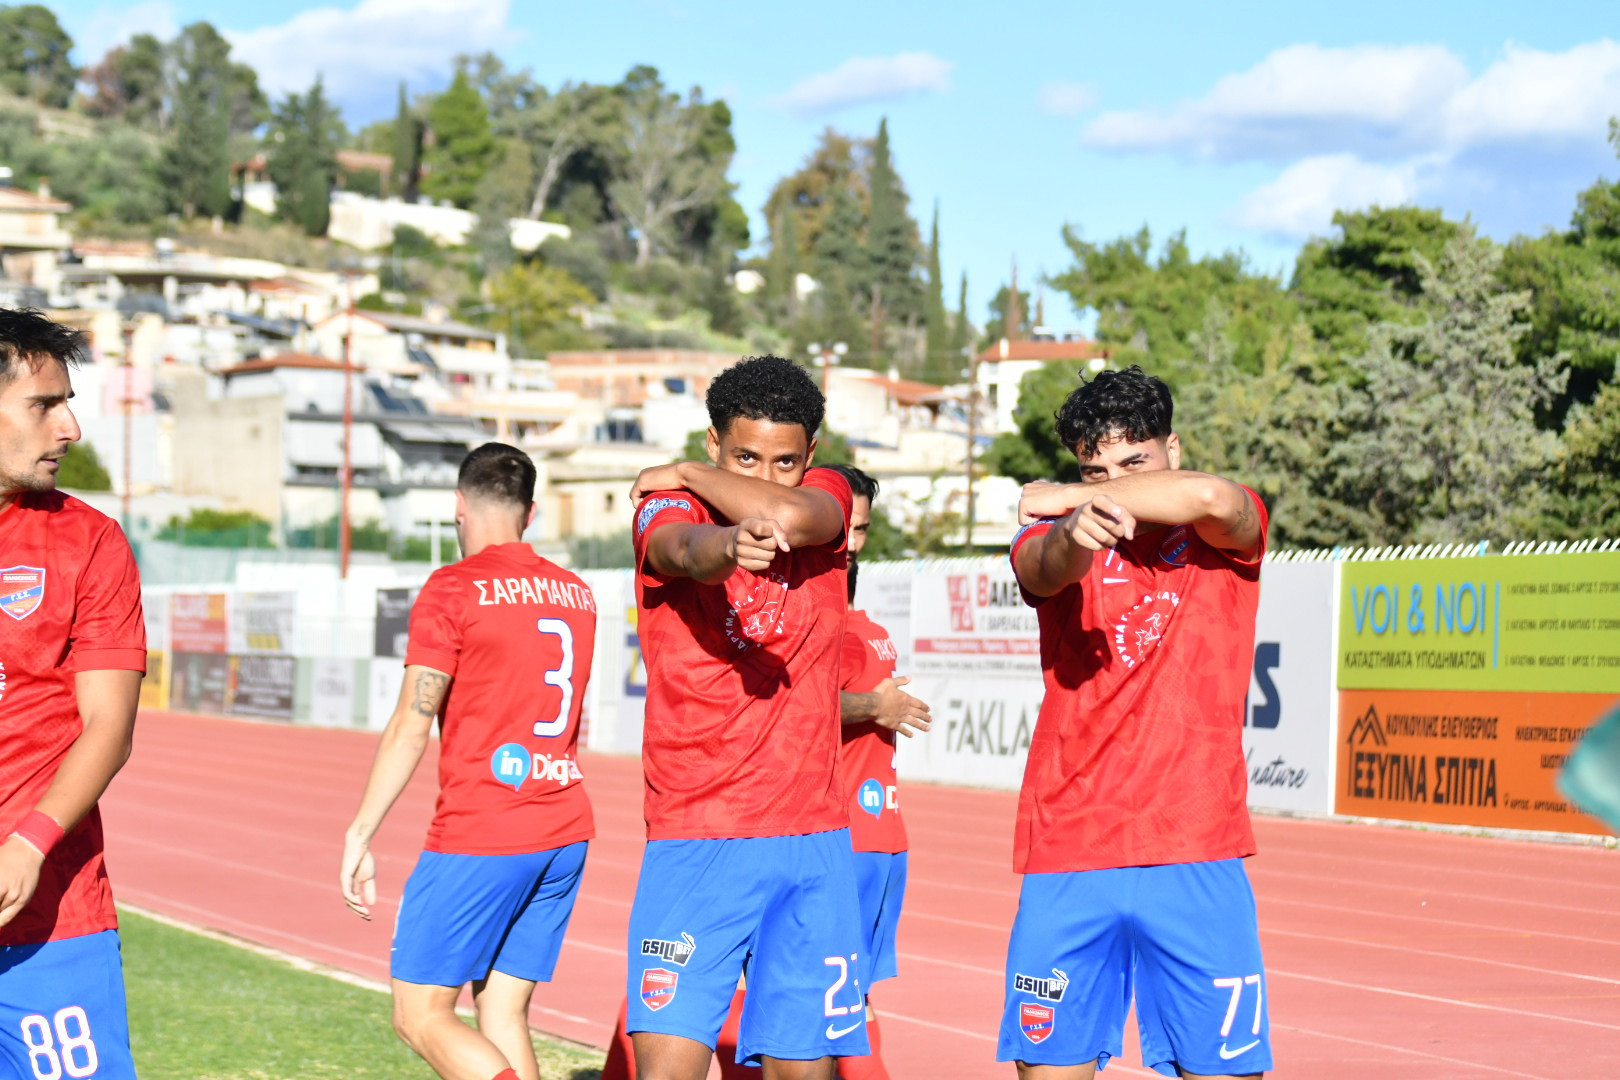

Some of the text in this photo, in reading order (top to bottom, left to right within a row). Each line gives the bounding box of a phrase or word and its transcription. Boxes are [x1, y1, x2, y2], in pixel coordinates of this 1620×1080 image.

[1351, 581, 1485, 634] VOI & NOI
[533, 617, 574, 737] 3
[1345, 651, 1485, 669] ΚΑΤΑΣΤΗΜΑΤΑ ΥΠΟΔΗΜΑΤΩΝ
[946, 699, 1041, 755] FAKLA
[500, 751, 522, 776] in
[1250, 755, 1307, 788] nature
[1354, 752, 1497, 807] ΕΞΥΠΝΑ ΣΠΙΤΙΑ
[864, 785, 879, 806] in
[1214, 974, 1261, 1037] 77
[20, 1005, 98, 1080] 88
